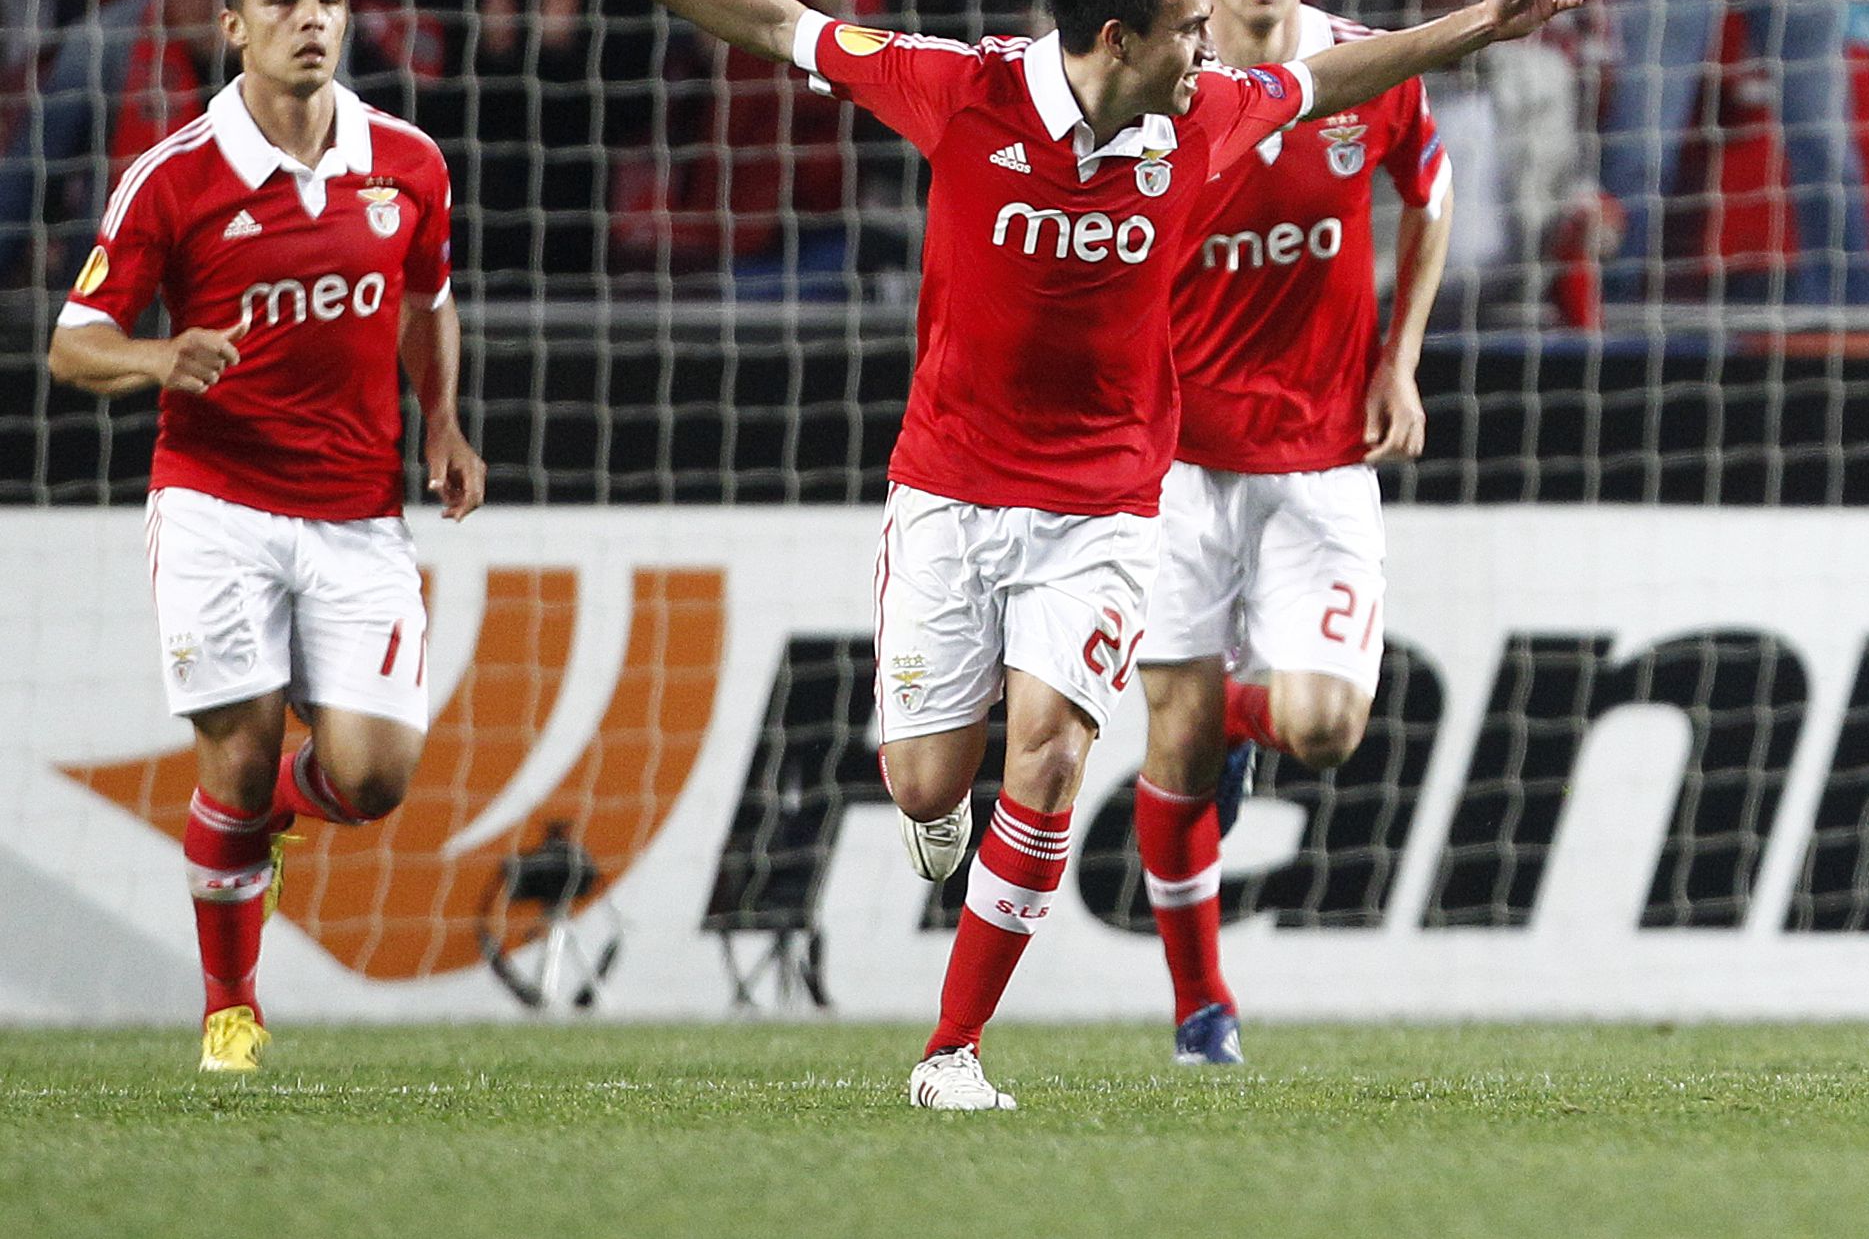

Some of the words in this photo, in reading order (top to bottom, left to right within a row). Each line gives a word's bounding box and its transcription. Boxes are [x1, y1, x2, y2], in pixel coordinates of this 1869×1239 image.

[989, 153, 1032, 174] adidas
[992, 202, 1156, 264] meo
[1203, 217, 1343, 273] meo
[242, 271, 386, 326] meo
[1320, 580, 1378, 651] 21
